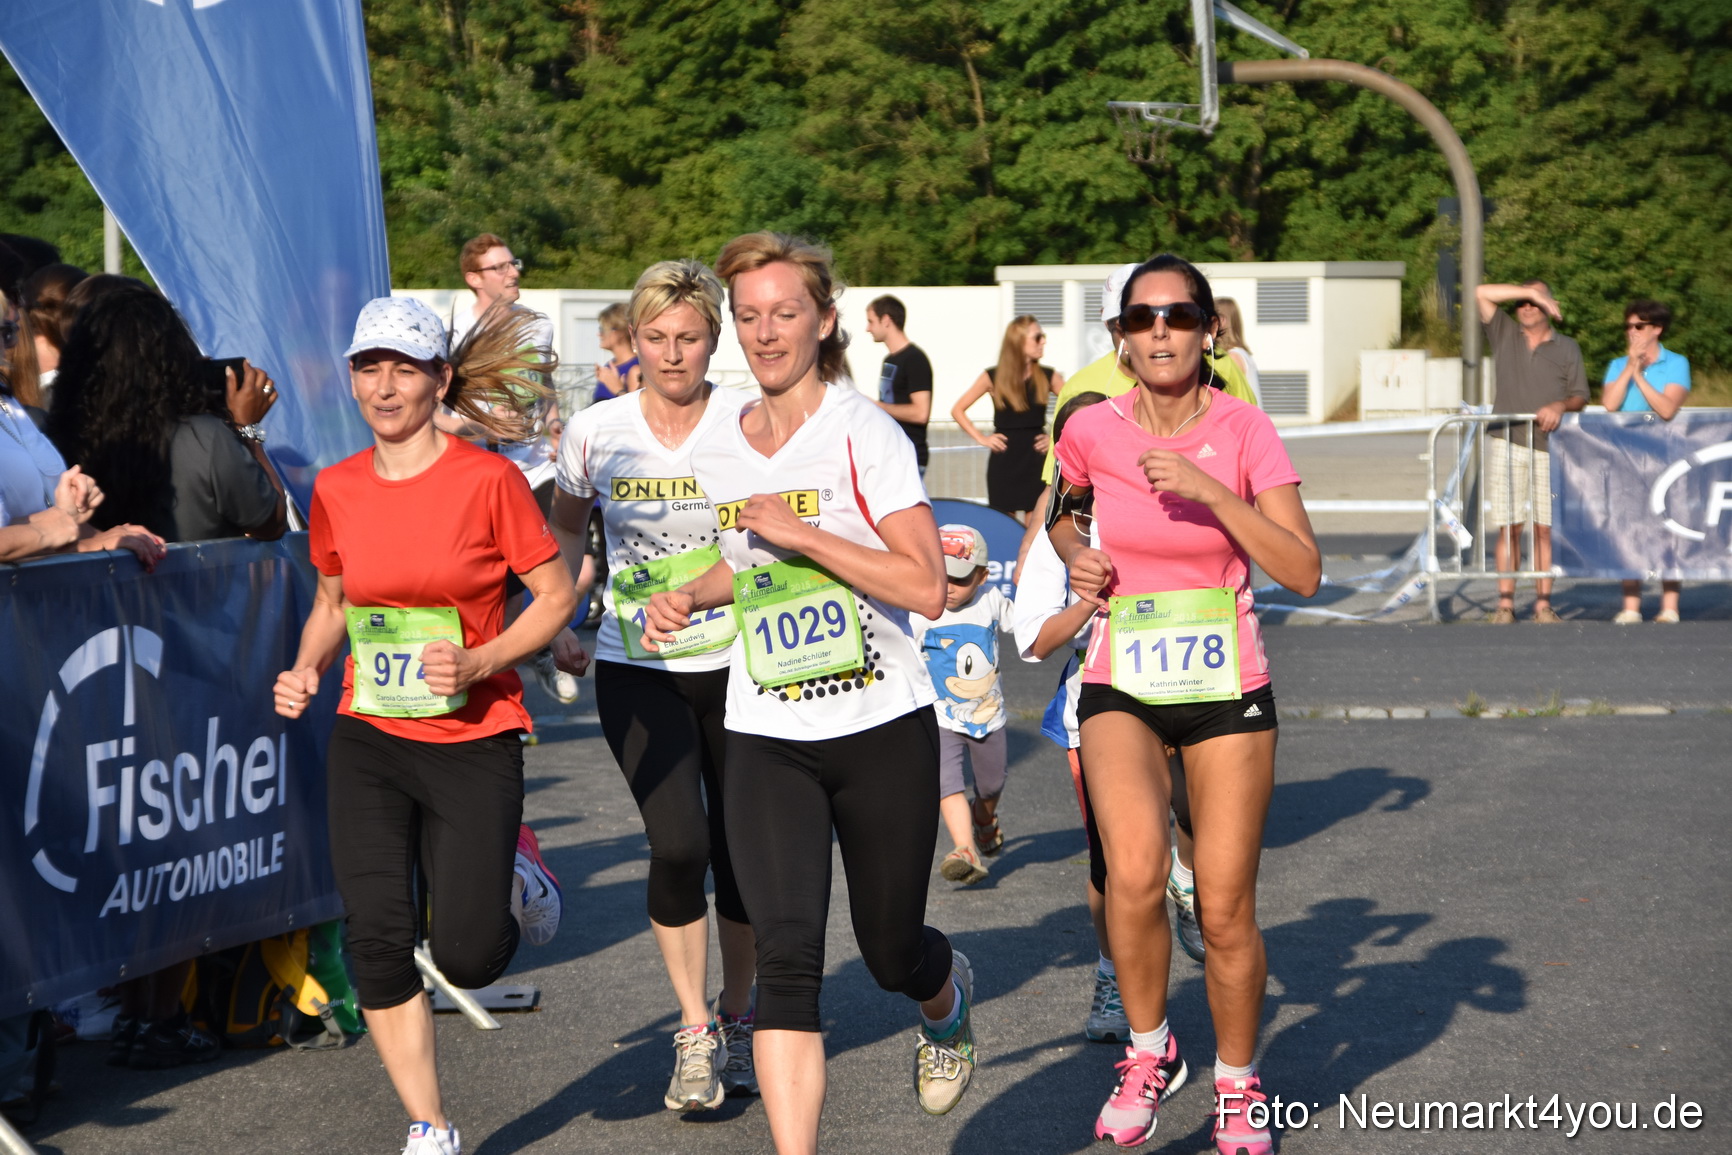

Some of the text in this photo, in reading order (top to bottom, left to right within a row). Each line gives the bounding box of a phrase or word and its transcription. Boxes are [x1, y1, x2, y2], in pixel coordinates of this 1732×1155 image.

[628, 576, 666, 592] firmenlauf
[750, 580, 788, 599] firmenlauf
[790, 580, 811, 593] 2015
[1128, 609, 1172, 621] firmenlauf
[365, 626, 398, 635] firmenlauf
[755, 600, 847, 655] 1029
[679, 633, 705, 644] Ludwig
[778, 650, 831, 668] Nadine Schlüter
[1125, 634, 1226, 673] 1178
[1149, 680, 1178, 688] Kathrin
[376, 694, 395, 702] Carola
[1243, 710, 1263, 718] adidas
[99, 831, 286, 918] AUTOMOBILE
